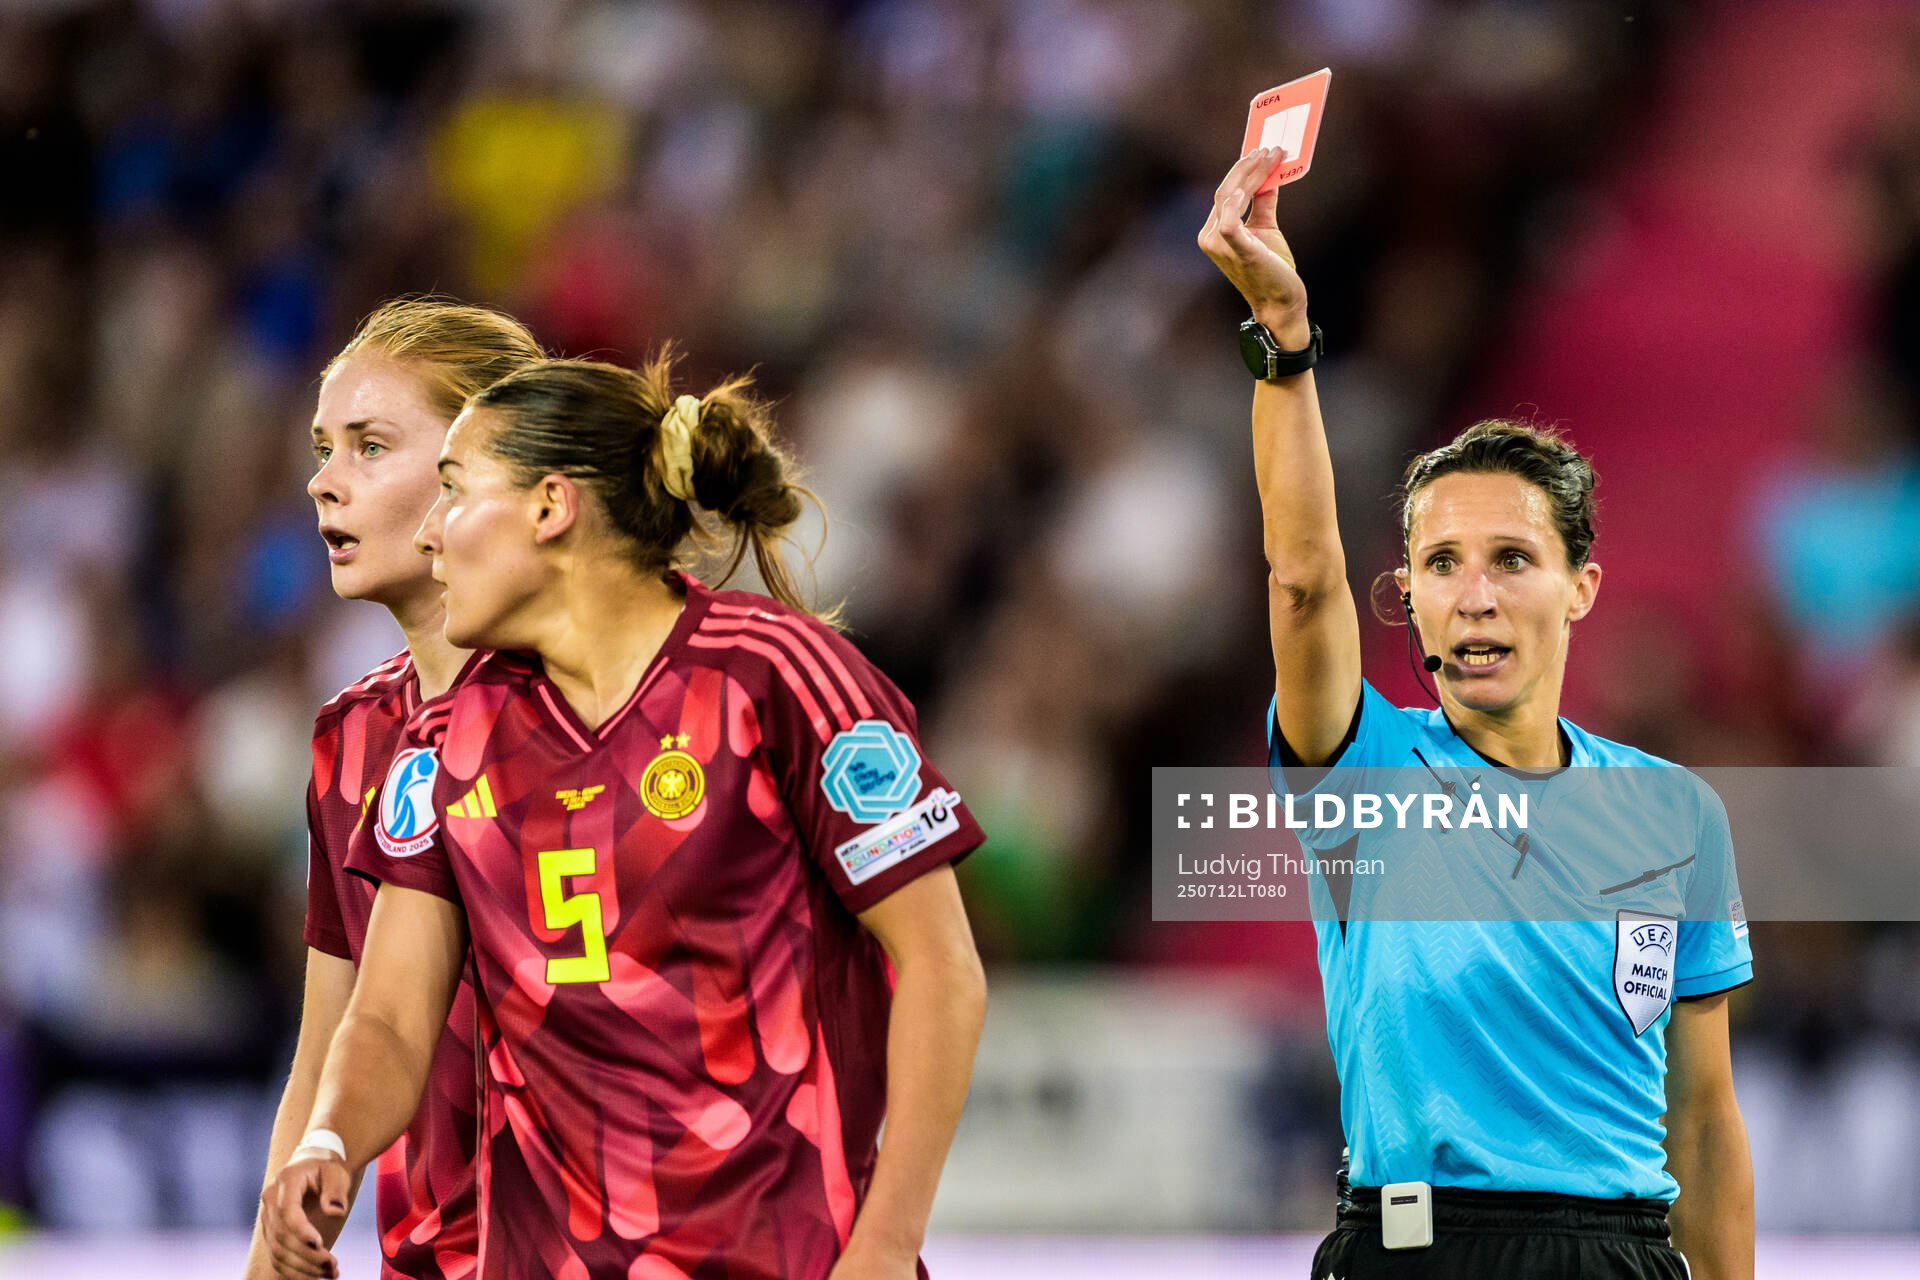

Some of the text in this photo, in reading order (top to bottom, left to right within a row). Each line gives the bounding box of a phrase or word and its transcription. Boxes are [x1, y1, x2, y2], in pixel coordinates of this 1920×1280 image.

[1256, 94, 1281, 109] UEFA
[1280, 165, 1303, 180] UEFA
[409, 838, 429, 852] 2025
[845, 824, 922, 870] FOUNDATION
[537, 848, 611, 984] 5
[1632, 928, 1673, 953] UEFA
[1631, 963, 1668, 981] MATCH
[1624, 981, 1667, 1001] OFFICIAL
